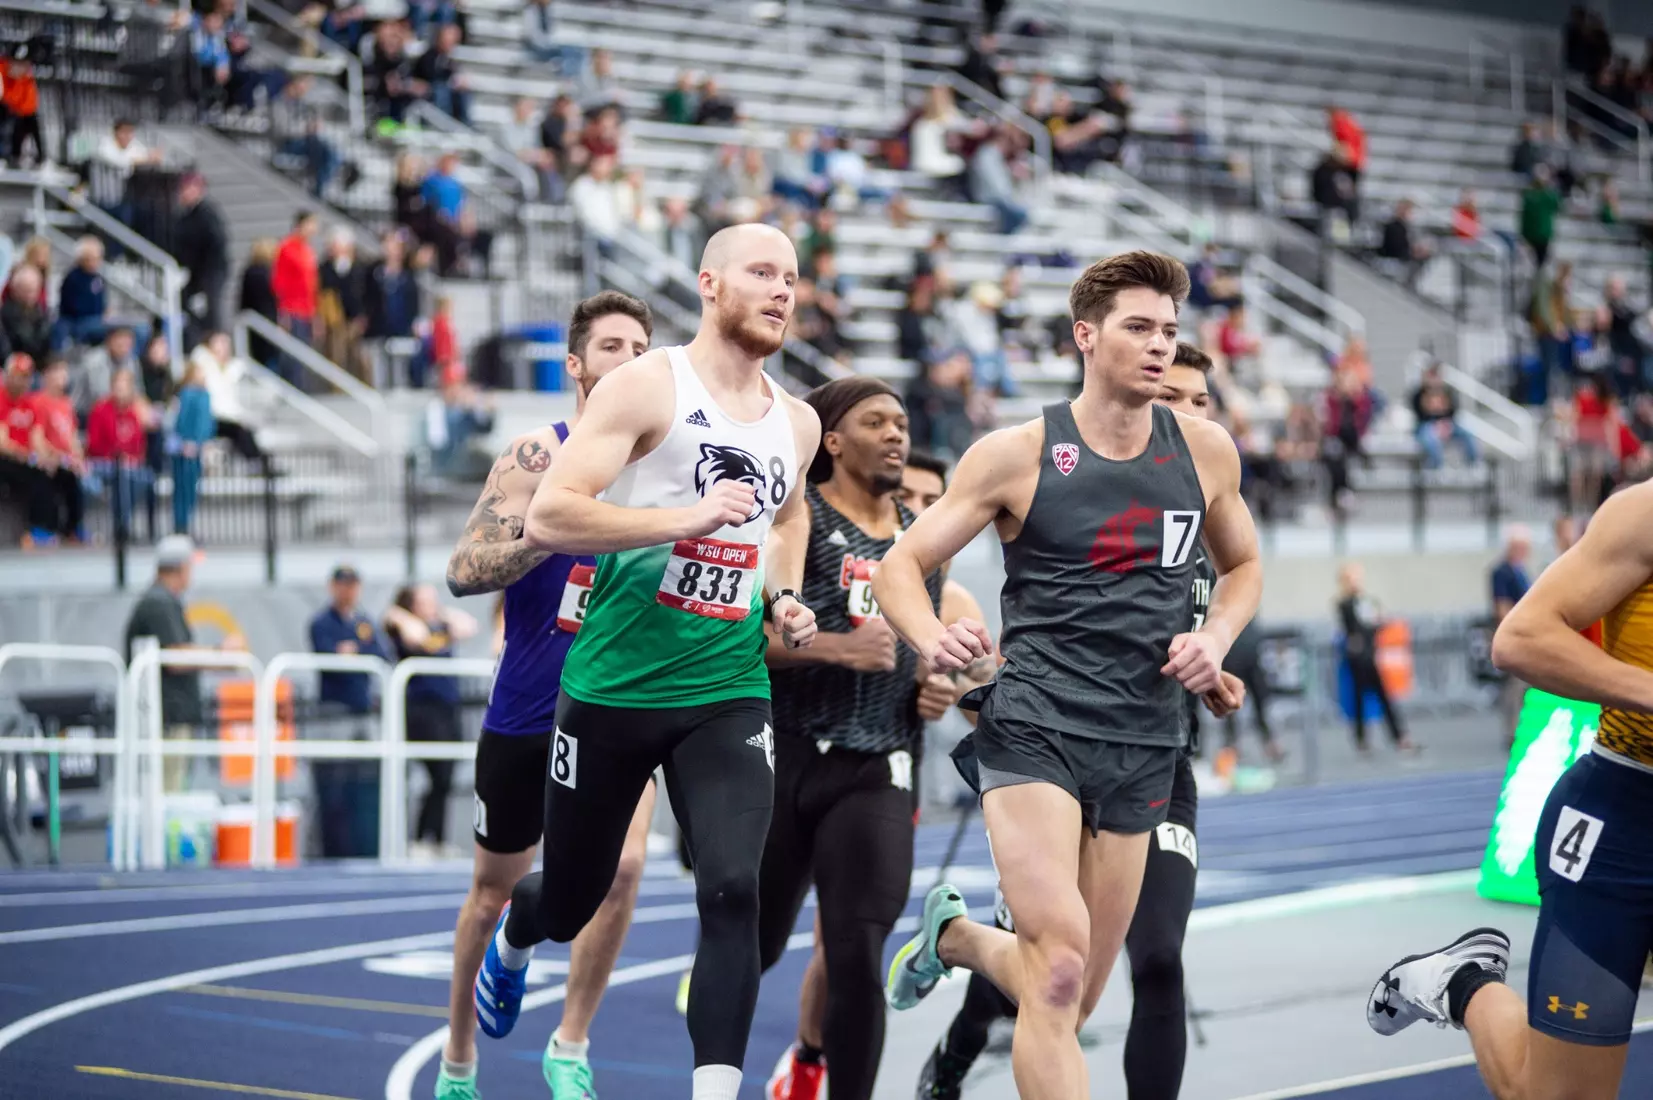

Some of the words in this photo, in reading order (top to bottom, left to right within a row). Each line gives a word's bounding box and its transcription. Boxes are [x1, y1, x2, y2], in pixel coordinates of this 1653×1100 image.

[685, 417, 711, 428] adidas
[1054, 445, 1078, 463] PAC
[1060, 457, 1072, 469] 12
[768, 455, 787, 506] 8
[697, 543, 721, 559] WSU
[722, 547, 748, 563] OPEN
[1172, 514, 1194, 564] 7
[676, 561, 743, 605] 833
[1192, 578, 1210, 606] TH
[554, 734, 571, 782] 8
[1167, 826, 1194, 860] 14
[1555, 817, 1590, 874] 4
